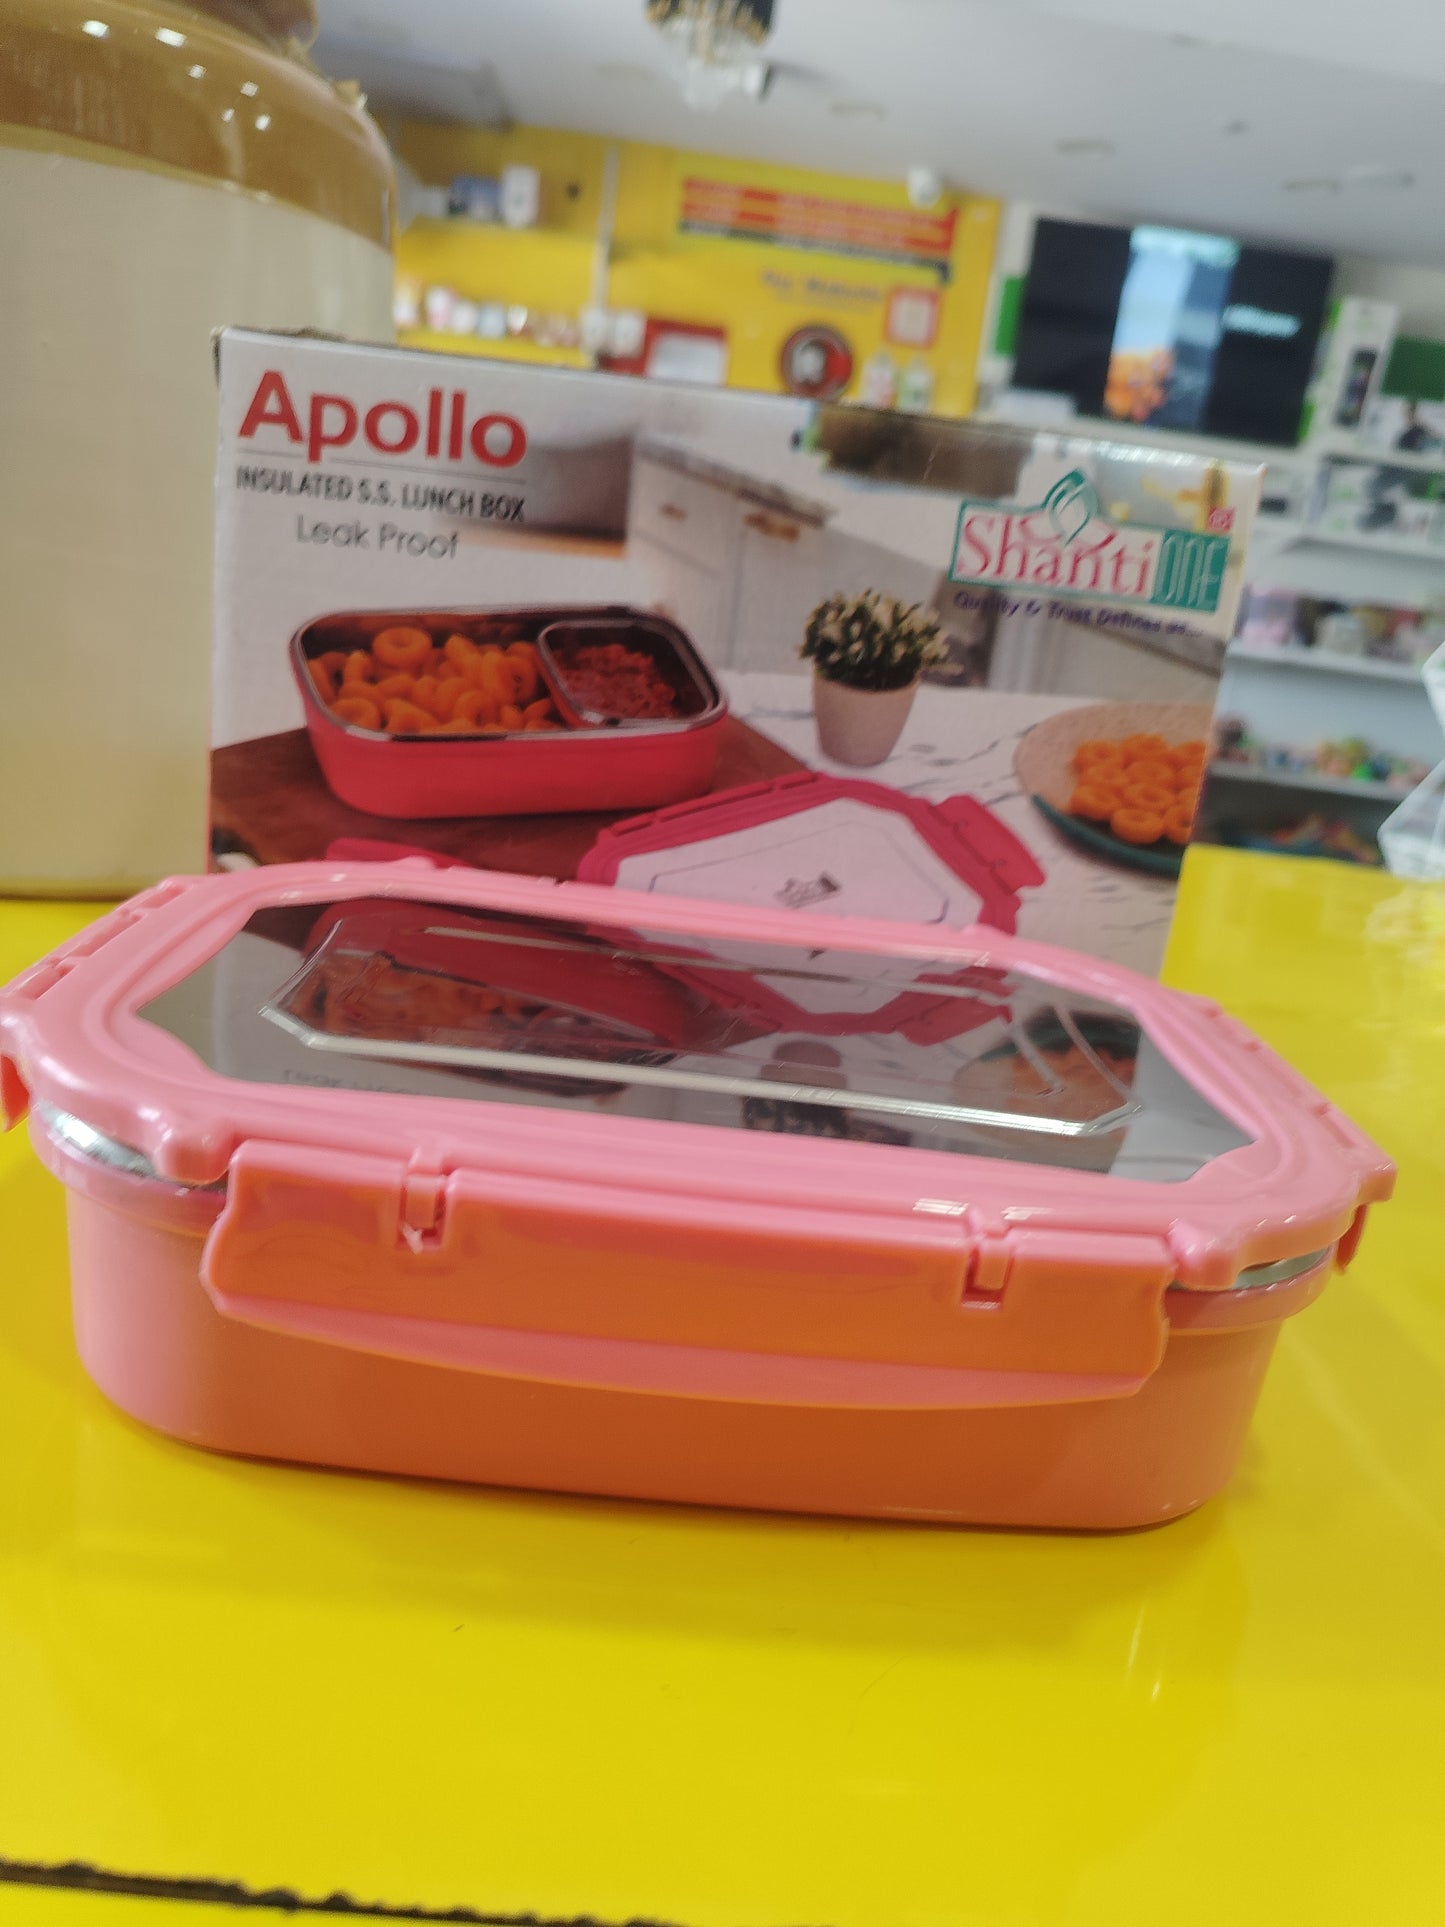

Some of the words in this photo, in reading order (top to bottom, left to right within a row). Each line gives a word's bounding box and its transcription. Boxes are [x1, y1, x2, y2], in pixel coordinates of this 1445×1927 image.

[238, 369, 527, 468] Apollo
[236, 465, 352, 501] INSULATED
[357, 478, 396, 507] S.S.
[401, 483, 475, 516] LUNCH
[479, 491, 526, 522] BOX
[296, 514, 370, 549] Leak
[379, 521, 459, 560] Proof
[956, 513, 1154, 597] Shanti
